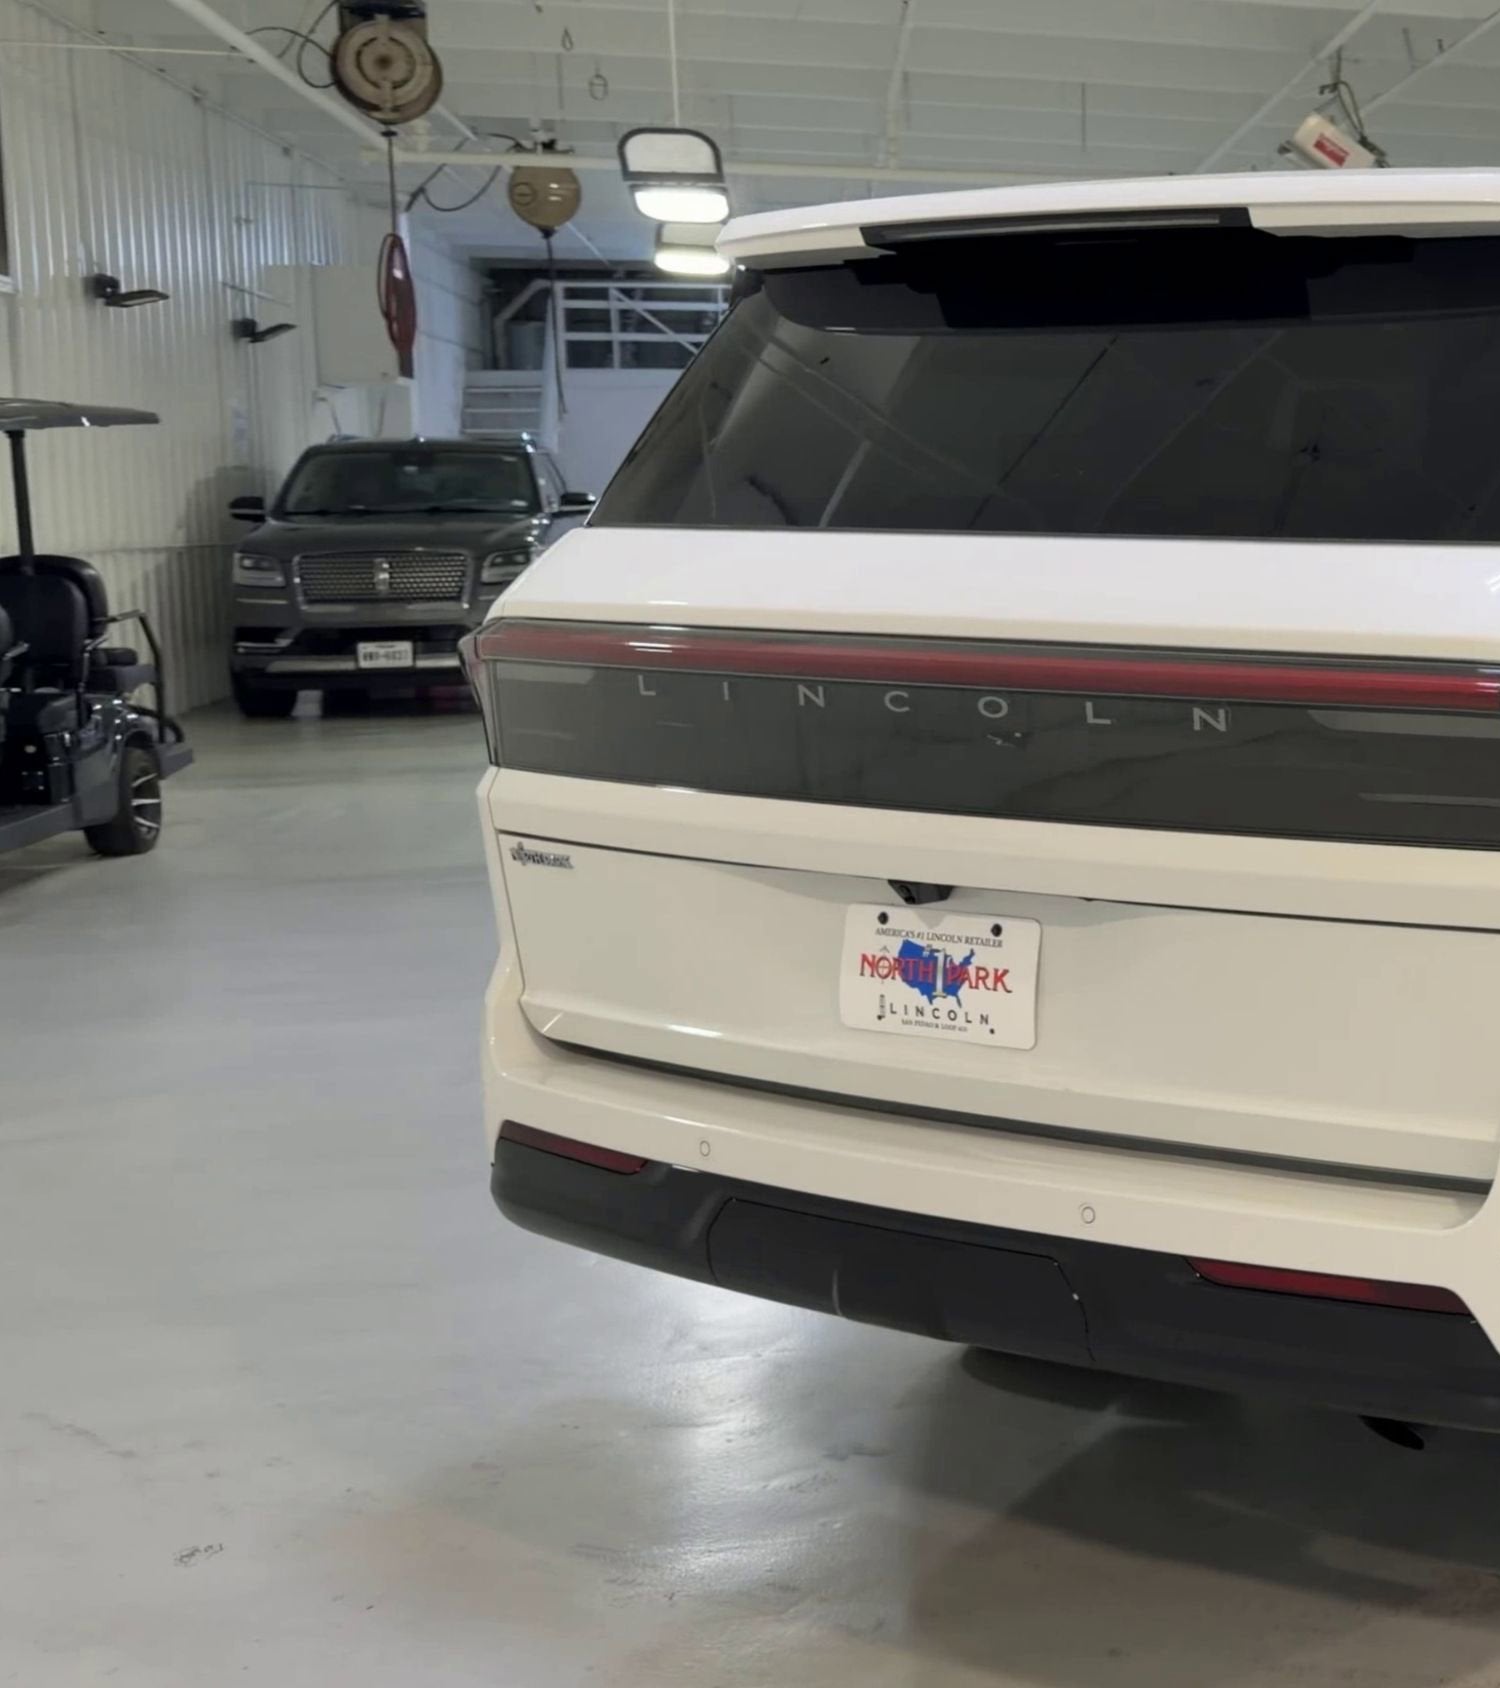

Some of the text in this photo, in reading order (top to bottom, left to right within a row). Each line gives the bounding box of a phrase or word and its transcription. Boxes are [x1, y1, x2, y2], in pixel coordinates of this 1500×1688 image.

[637, 674, 1228, 732] LINCOLN
[875, 927, 915, 939] AMERICA'S
[926, 931, 964, 944] LINCOLN
[964, 936, 1003, 948] RETAILER
[859, 953, 1013, 994] NORTH PARK
[889, 1002, 989, 1025] LINCOLN
